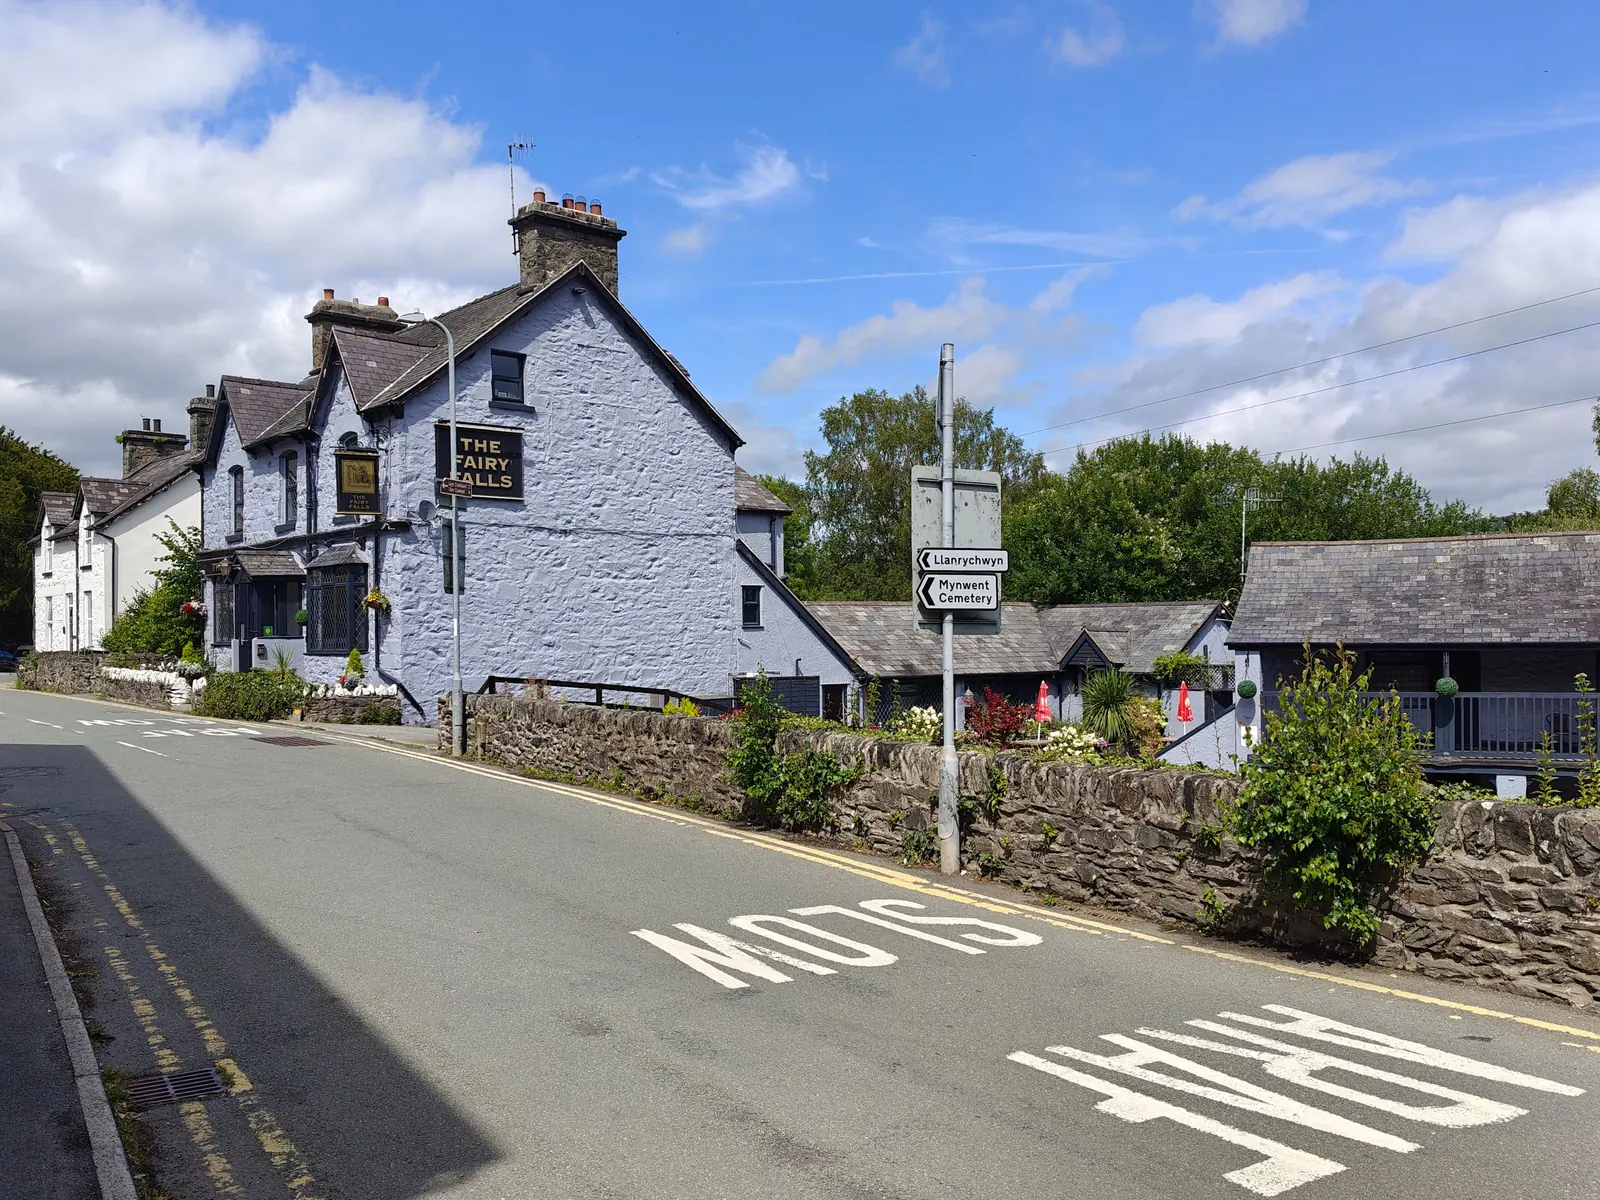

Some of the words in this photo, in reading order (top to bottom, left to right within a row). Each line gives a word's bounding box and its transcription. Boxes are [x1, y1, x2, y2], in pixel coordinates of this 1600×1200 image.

[460, 437, 500, 453] THE
[456, 454, 509, 471] FAIRY
[934, 554, 1004, 567] Llanrychwyn
[939, 579, 990, 591] Mynwent
[939, 592, 993, 605] Cemetery
[76, 718, 217, 726] SLOW
[140, 727, 264, 738] ARAF
[629, 898, 1044, 989] SLOW
[1006, 1003, 1586, 1198] ARAF
